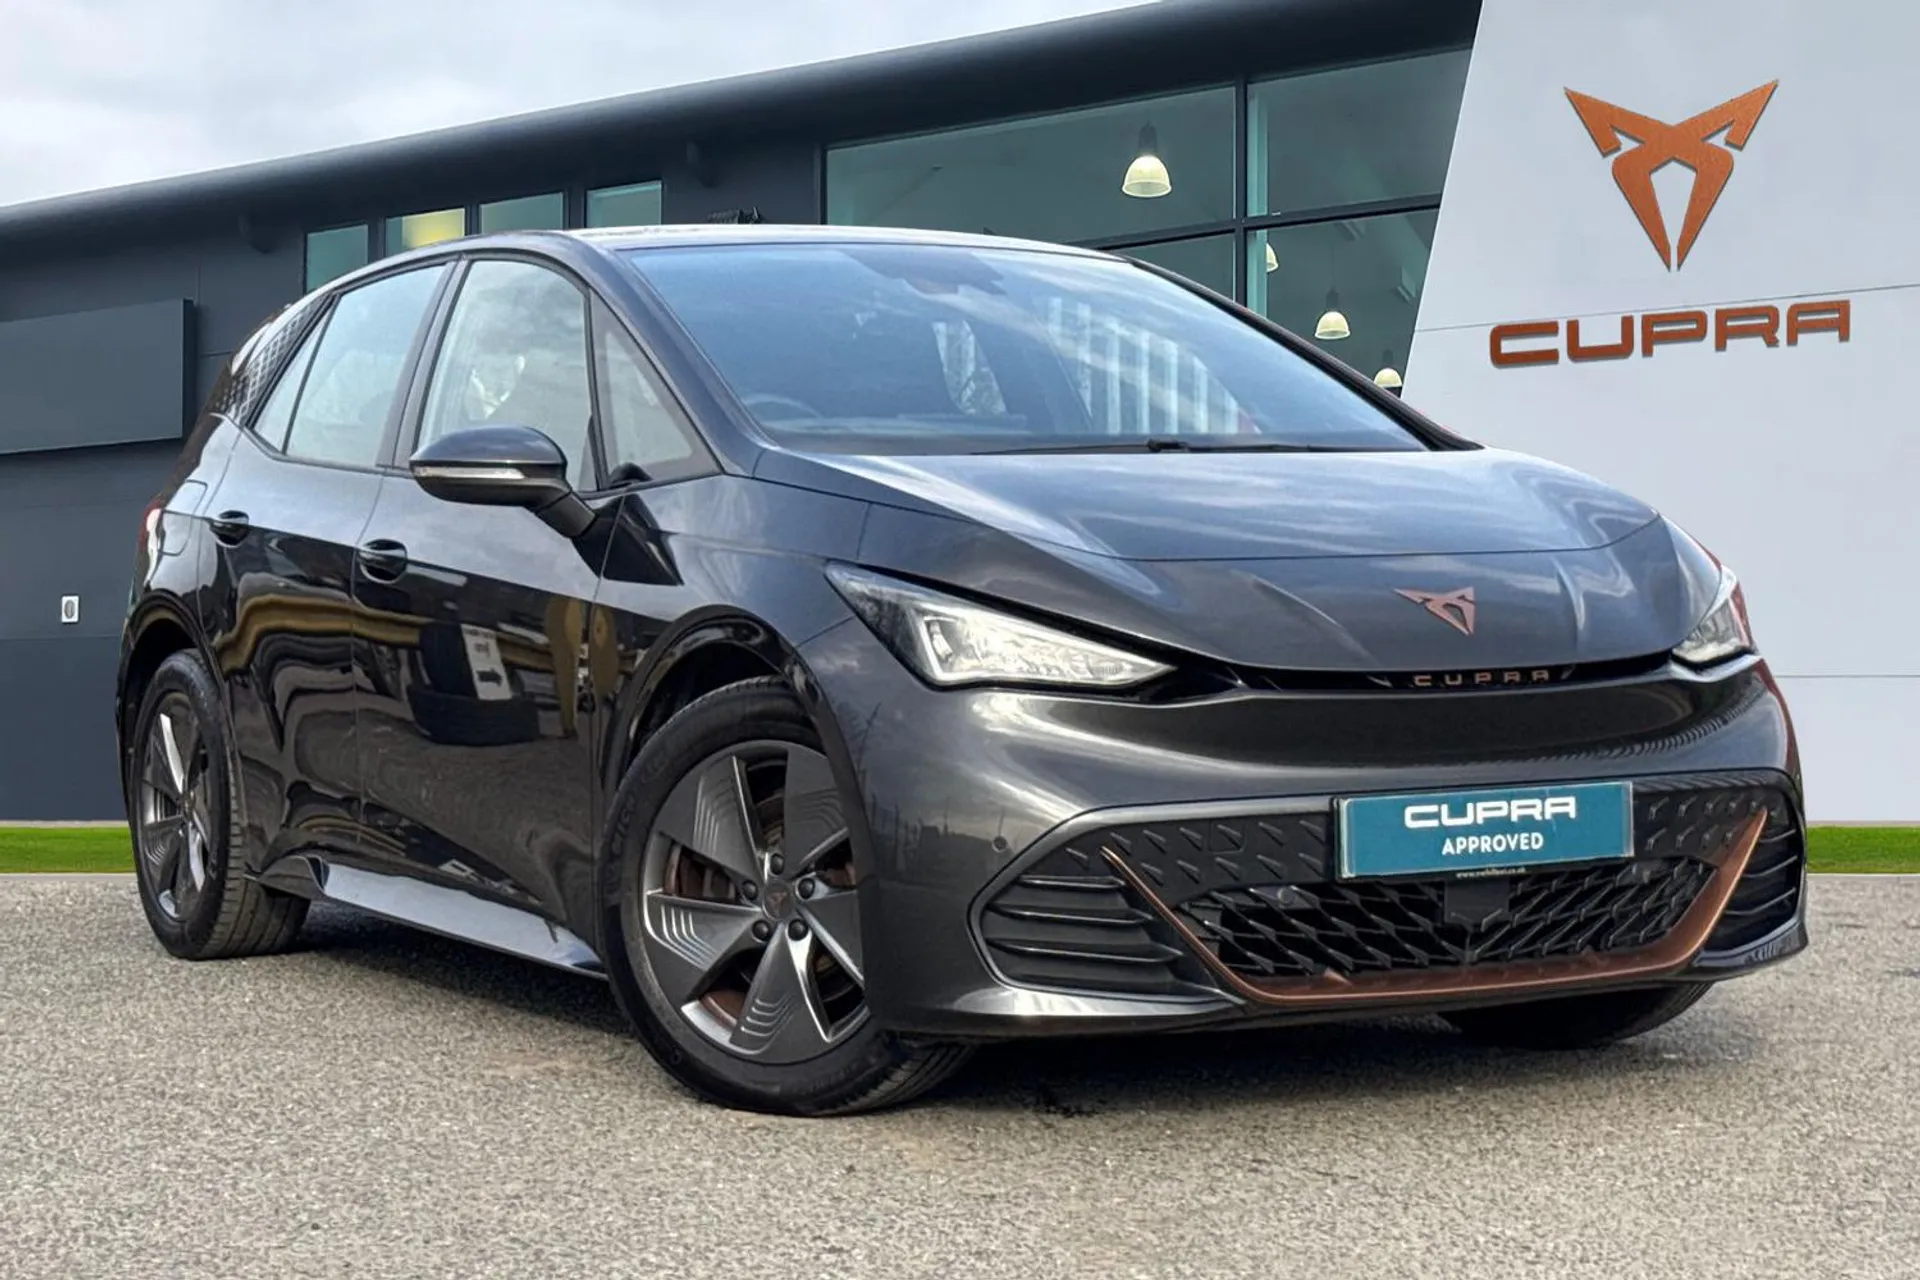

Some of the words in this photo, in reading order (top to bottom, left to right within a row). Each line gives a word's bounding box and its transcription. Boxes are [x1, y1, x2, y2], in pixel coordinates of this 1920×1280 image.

[1490, 300, 1850, 368] CUPRA
[1414, 670, 1549, 686] CUPRA
[1404, 796, 1576, 829] CUPRA
[1442, 832, 1543, 856] APPROVED
